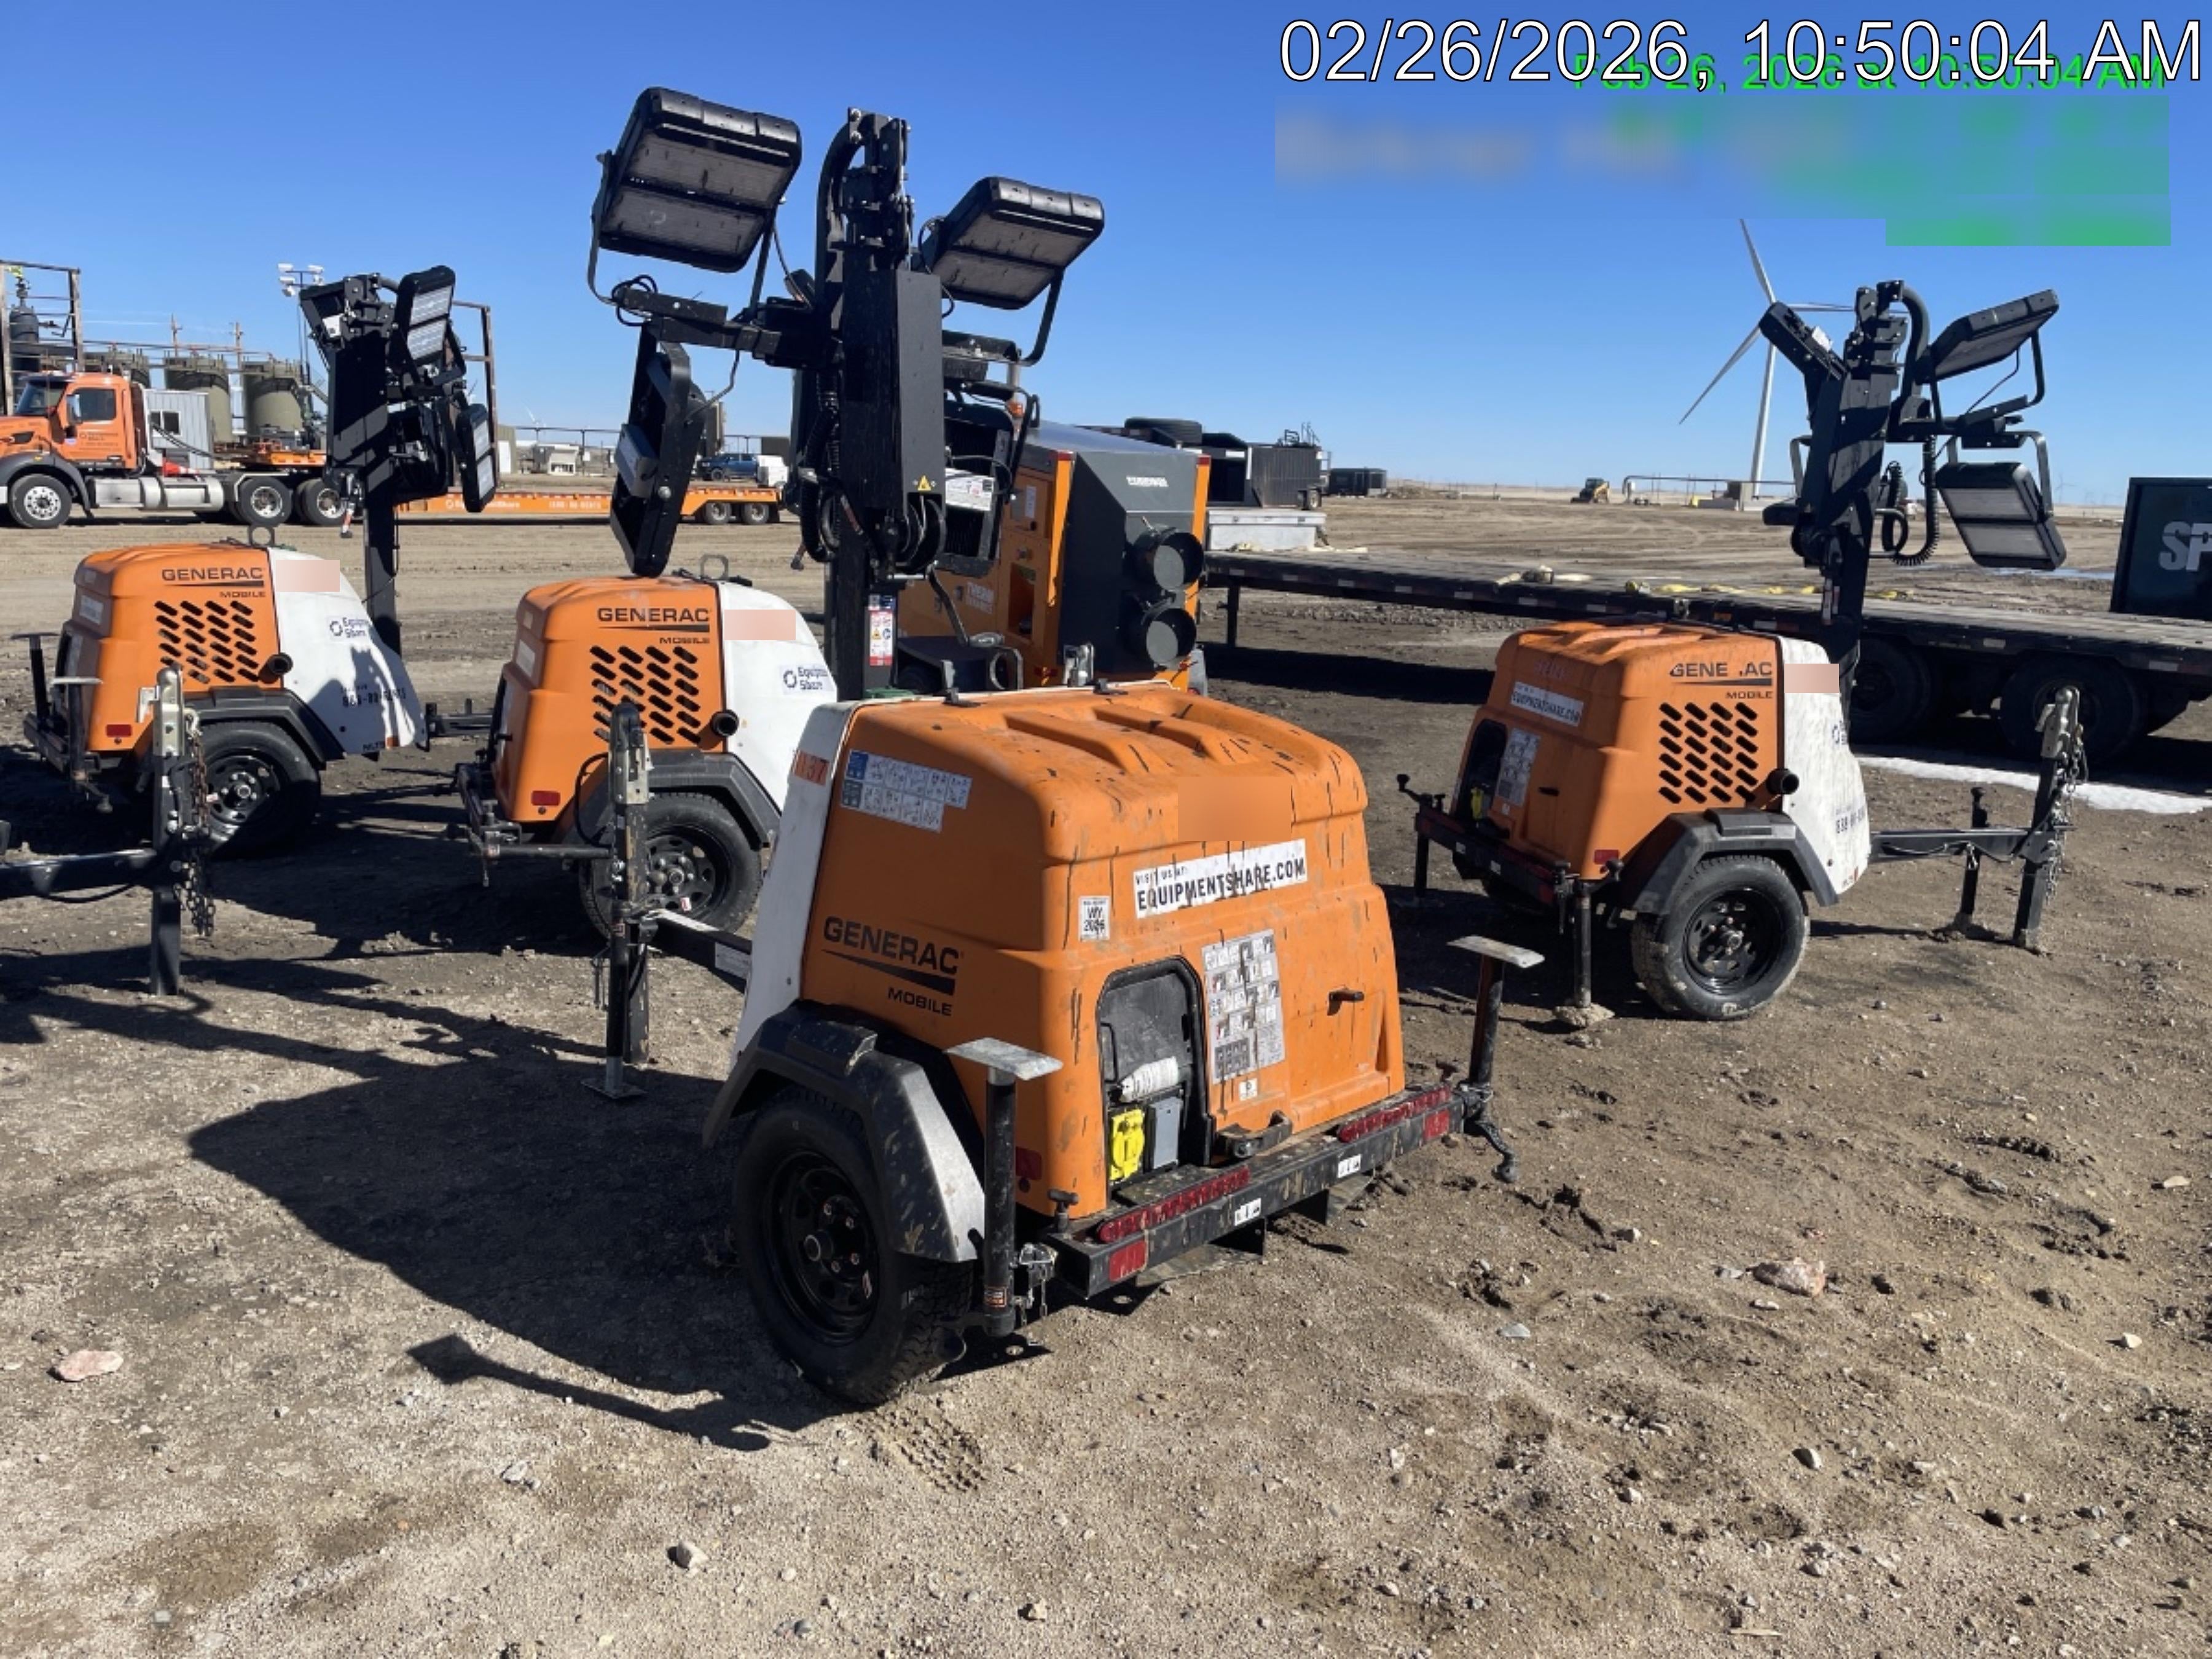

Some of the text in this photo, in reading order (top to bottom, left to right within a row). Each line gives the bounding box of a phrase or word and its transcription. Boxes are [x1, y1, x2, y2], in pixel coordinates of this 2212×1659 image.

[162, 567, 263, 581] GENERAC
[598, 608, 710, 622] GENERAC
[1669, 662, 1772, 677] GENEAC
[1137, 858, 1305, 911] EQUIPMENTSHARE.COM
[1087, 906, 1104, 919] WY
[823, 916, 959, 975] GENERAC
[888, 987, 952, 1016] MOBILE
